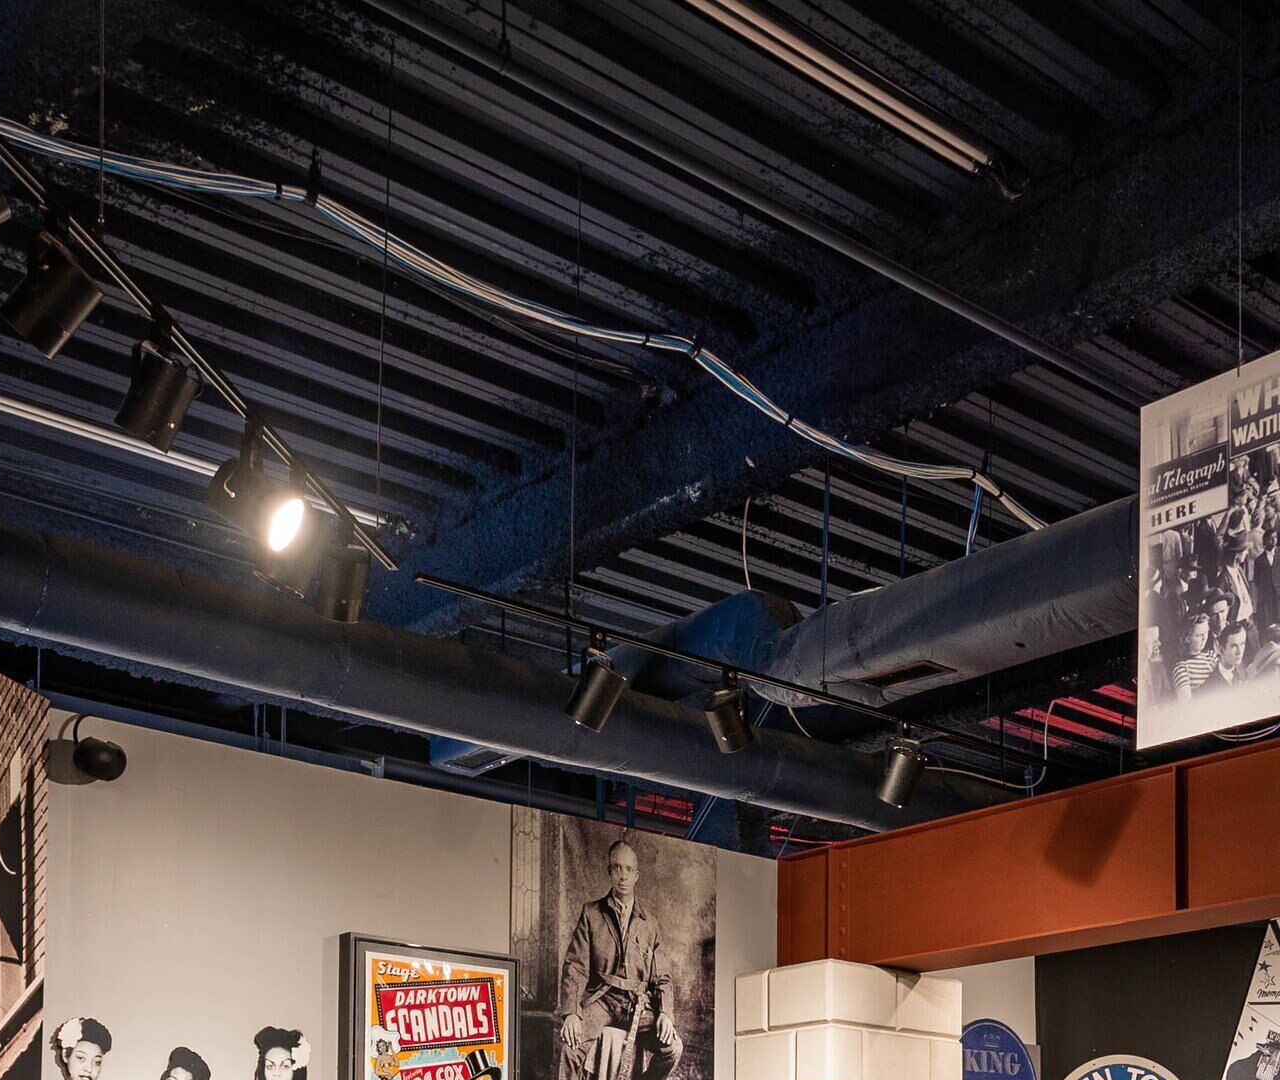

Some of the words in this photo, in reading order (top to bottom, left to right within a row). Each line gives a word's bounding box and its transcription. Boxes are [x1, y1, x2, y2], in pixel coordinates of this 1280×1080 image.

[1162, 453, 1226, 493] Telegraph
[1150, 500, 1198, 528] HERE
[376, 960, 421, 983] Stage
[395, 986, 481, 1006] DARKTOWN
[385, 1002, 489, 1042] SCANDALS
[964, 1048, 1022, 1076] KING
